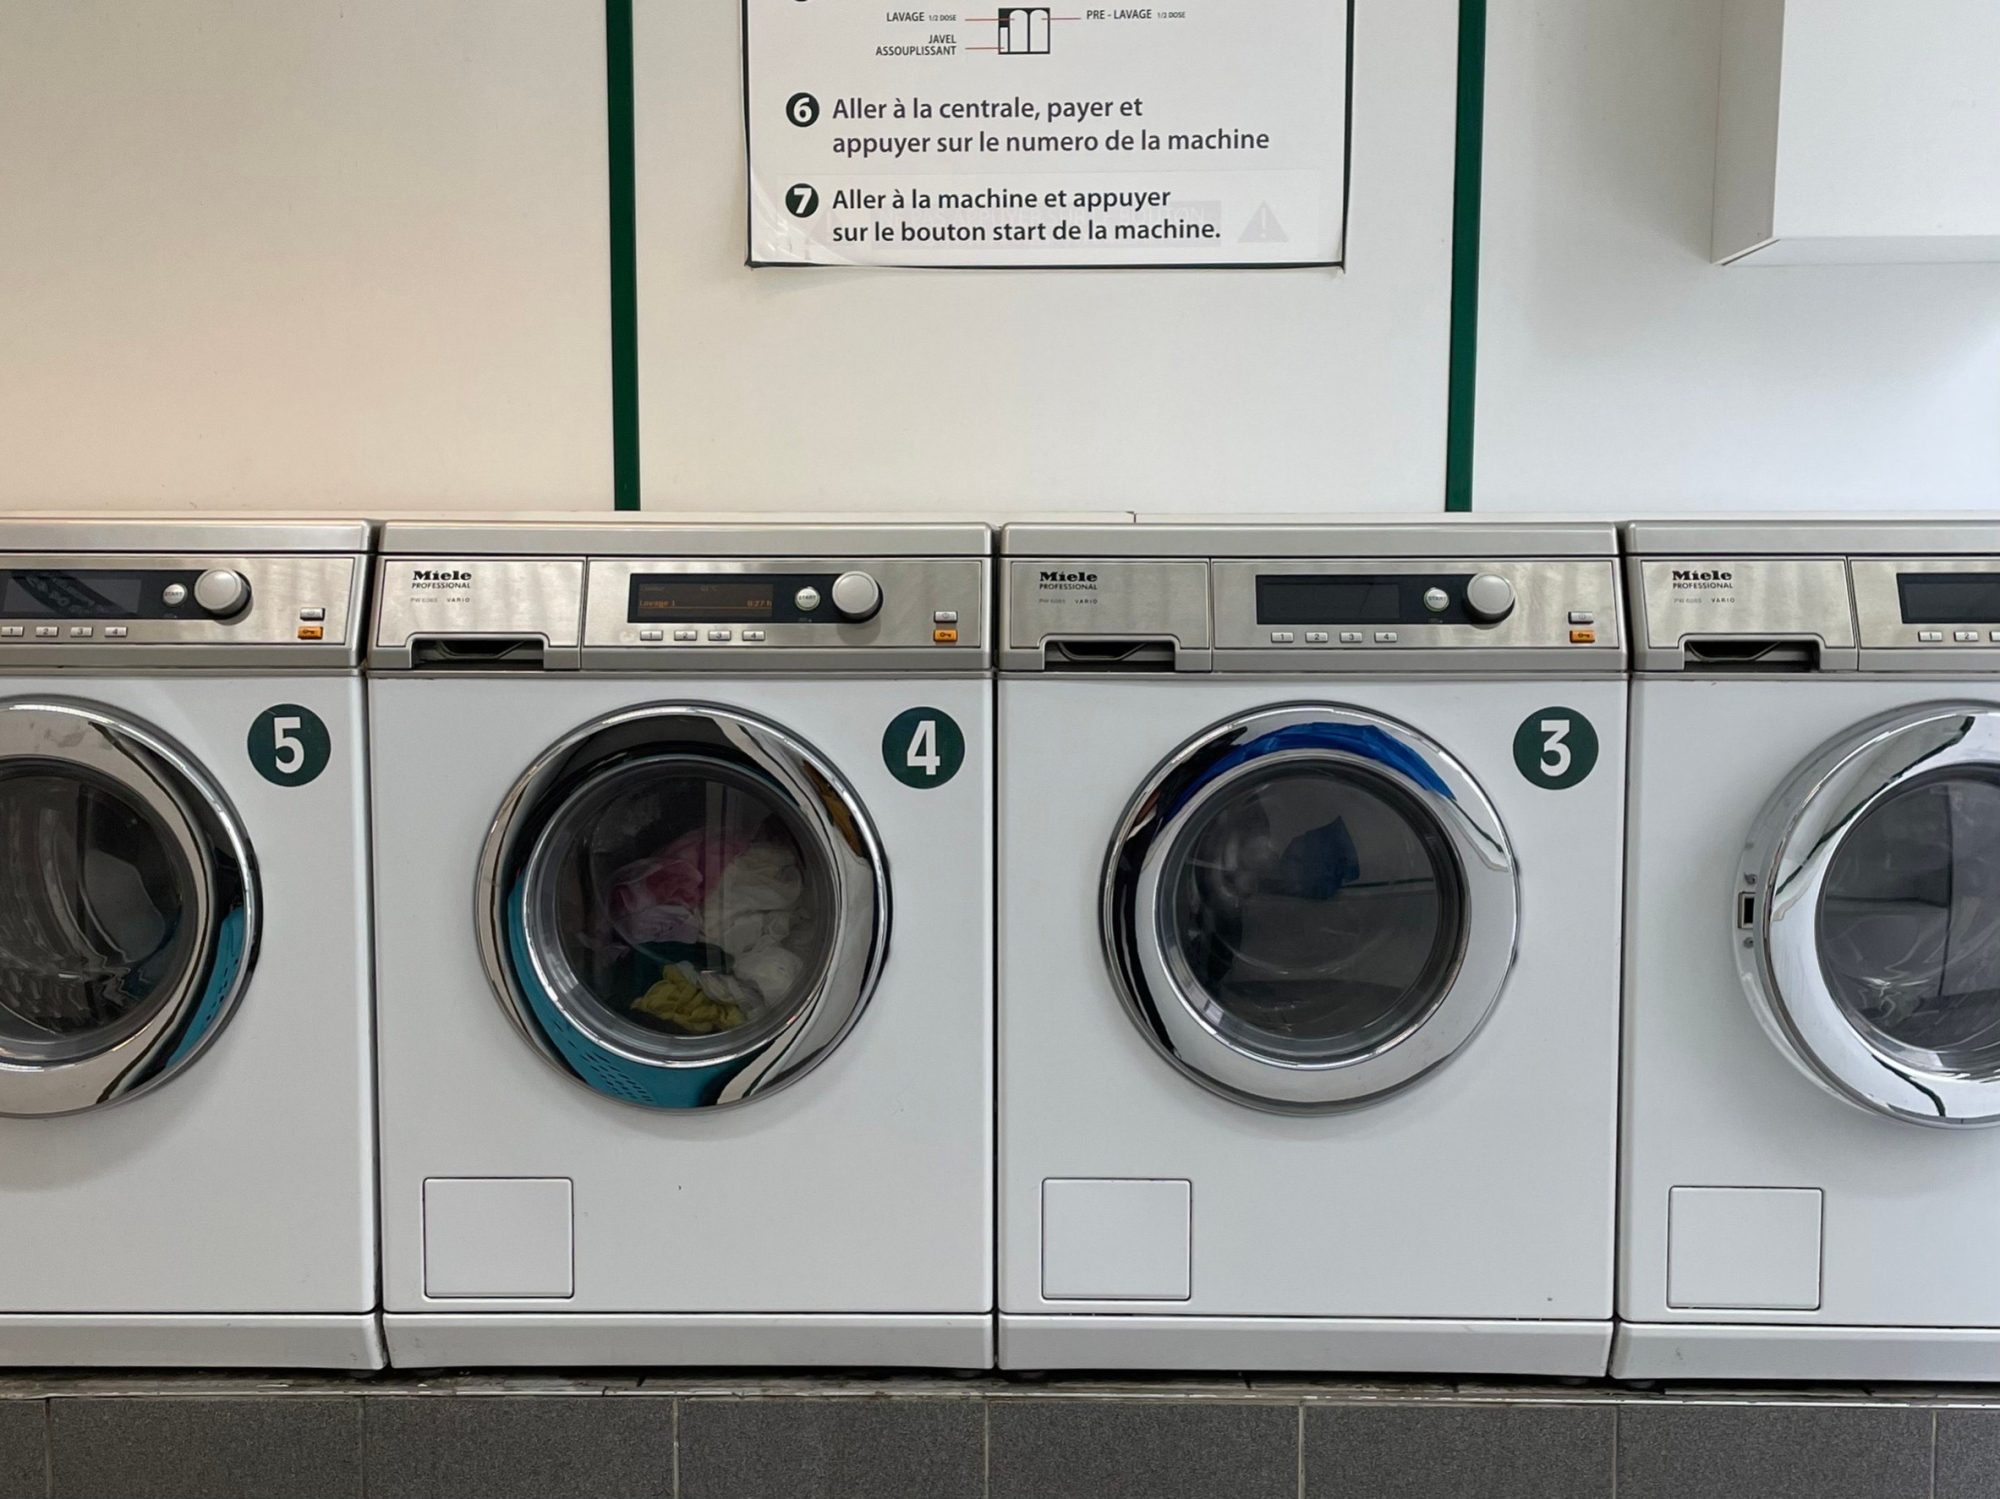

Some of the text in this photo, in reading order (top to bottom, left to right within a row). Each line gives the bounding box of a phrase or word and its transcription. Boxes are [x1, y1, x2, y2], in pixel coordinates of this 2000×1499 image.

[886, 11, 925, 22] LAVAGE
[1086, 9, 1106, 20] PRE
[1113, 8, 1152, 20] LAVAGE
[875, 45, 957, 56] ASSOUPLISSANT
[928, 34, 957, 44] JAVEL
[791, 96, 813, 124] 6
[833, 97, 1142, 122] Aller à la centrale, payer et
[834, 129, 1269, 158] appuyer sur le numero de la machine
[791, 187, 813, 214] 7
[833, 188, 1170, 212] Aller à la machine et appuyer
[834, 219, 1220, 241] sur le bouton start de la machine.
[412, 570, 472, 581] Miele
[1039, 571, 1098, 582] Miele
[1672, 570, 1732, 581] Miele
[273, 716, 305, 774] 5
[906, 720, 942, 775] 4
[1540, 719, 1571, 776] 3
